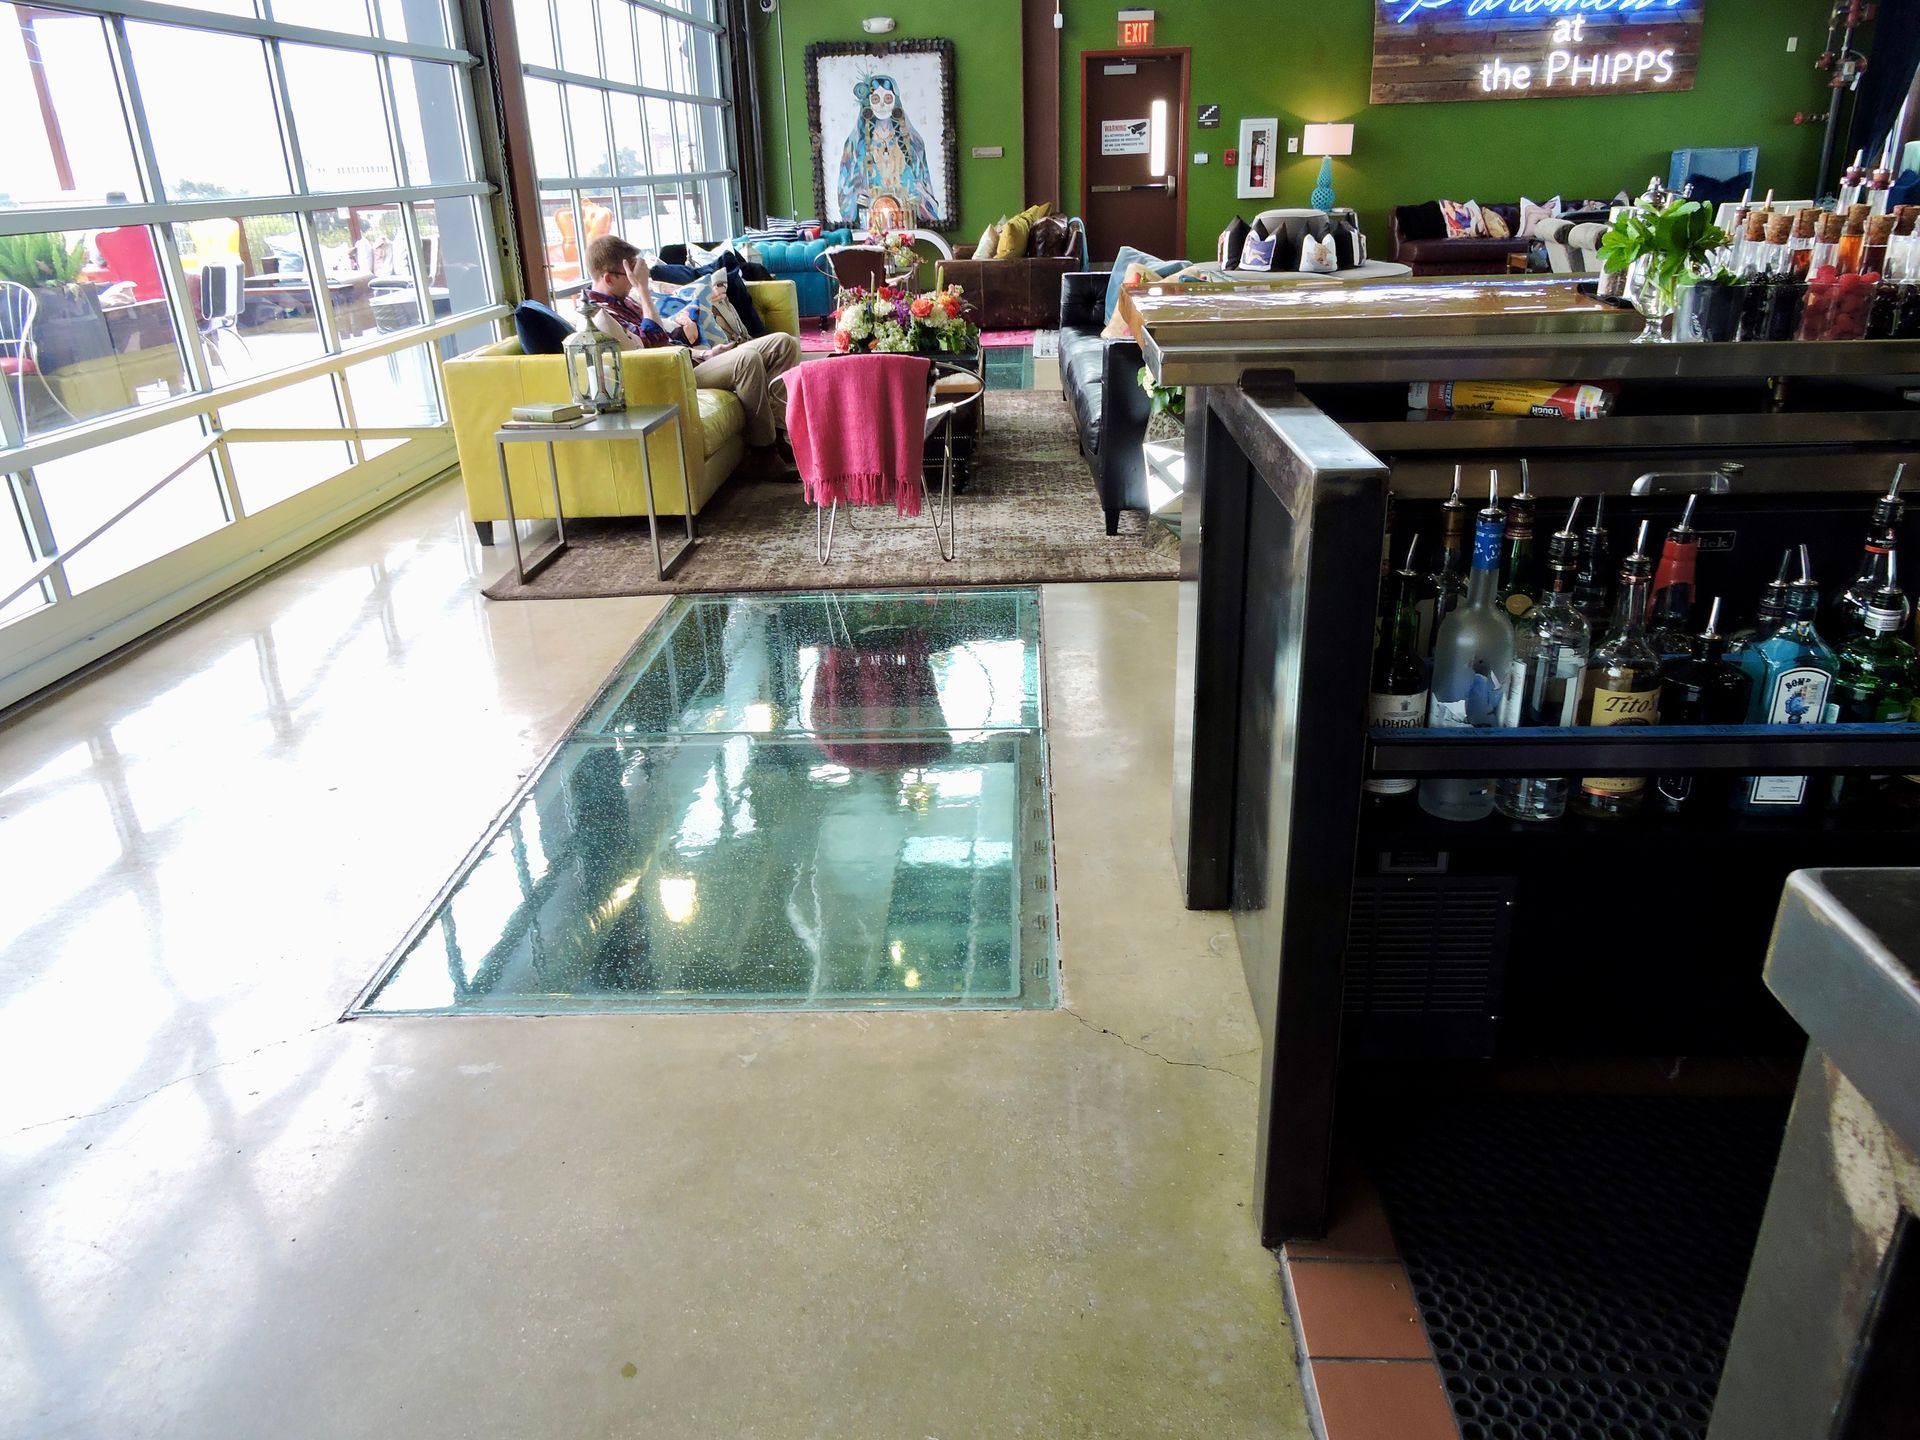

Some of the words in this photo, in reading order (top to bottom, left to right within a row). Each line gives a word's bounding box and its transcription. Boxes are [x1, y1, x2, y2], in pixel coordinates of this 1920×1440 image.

[1124, 22, 1149, 44] EXIT
[1552, 12, 1586, 43] at
[1479, 57, 1531, 92] the
[1546, 48, 1675, 88] PHIPPS
[1531, 406, 1560, 416] TOUGH
